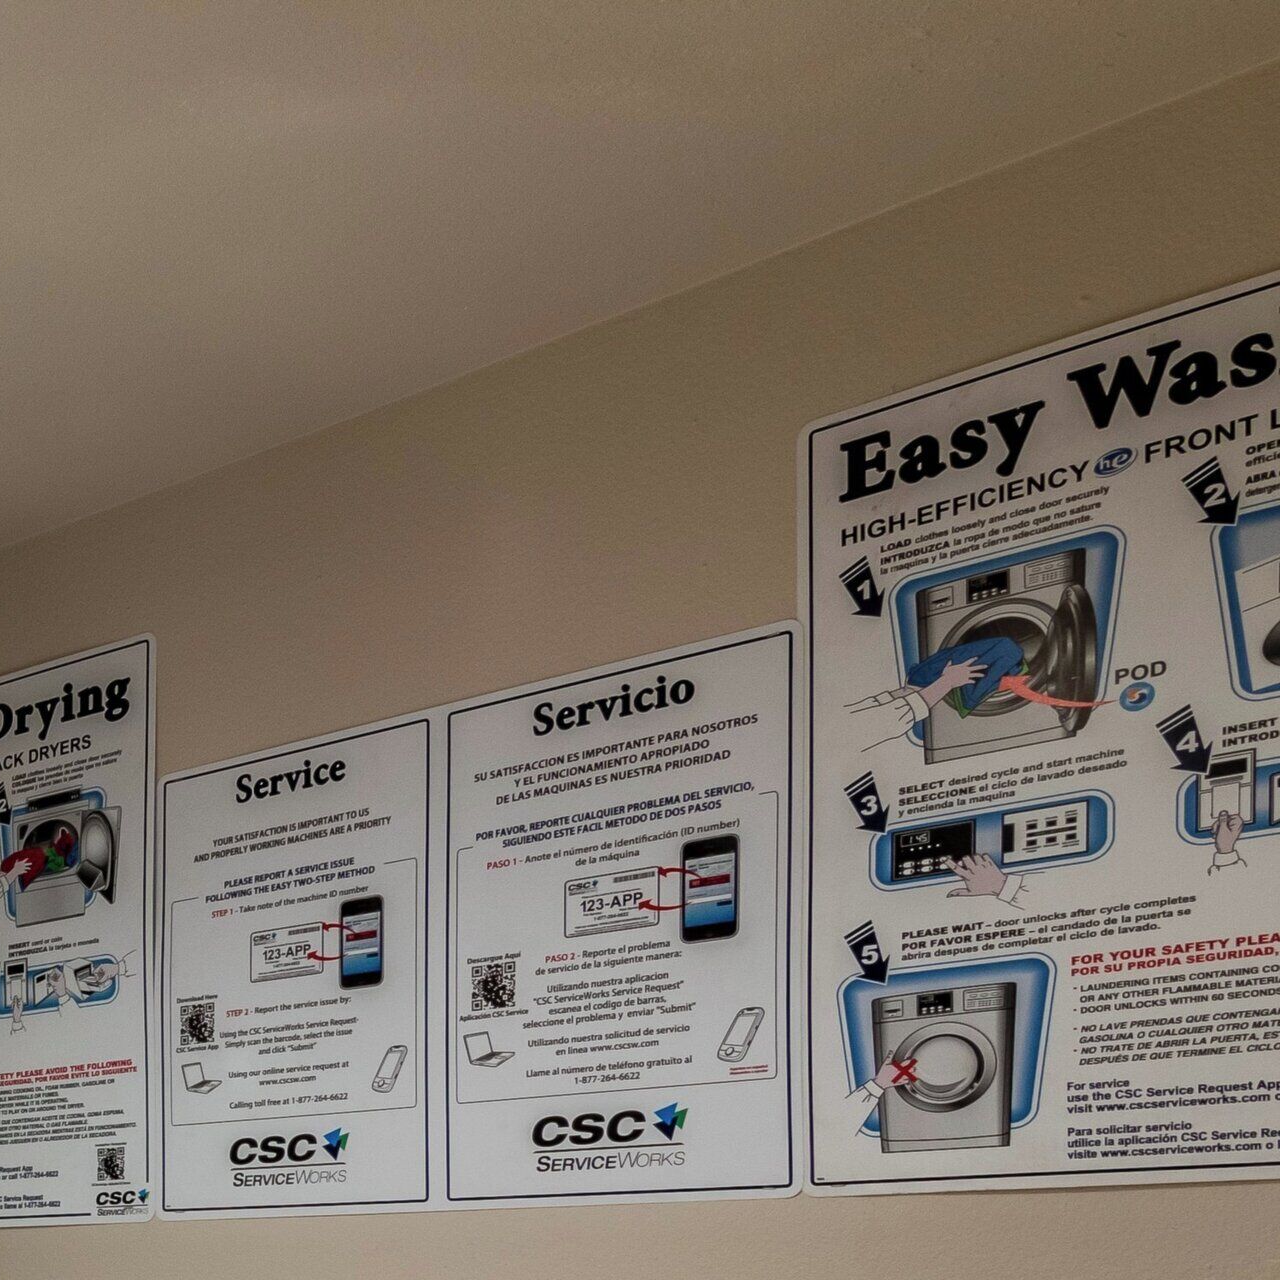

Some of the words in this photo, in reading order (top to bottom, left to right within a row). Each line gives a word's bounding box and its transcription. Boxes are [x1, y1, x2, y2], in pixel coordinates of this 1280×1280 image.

[838, 399, 1045, 503] Easy
[840, 460, 1090, 548] HIGH-EFFICIENCY
[1144, 414, 1259, 464] FRONT
[1203, 483, 1227, 508] 2
[879, 537, 912, 553] LOAD
[914, 529, 949, 544] clothes
[951, 518, 986, 534] loosely
[987, 511, 1007, 524] and
[1009, 505, 1036, 518] close
[1038, 498, 1063, 510] door
[1064, 485, 1110, 503] securely
[855, 579, 871, 597] 1
[1114, 659, 1168, 686] POD
[532, 674, 695, 736] Servicio
[1222, 717, 1279, 735] INSERT
[28, 734, 91, 764] DRYERS
[473, 771, 487, 783] SU
[489, 754, 564, 779] SATISFACCION
[566, 751, 580, 763] ES
[581, 735, 655, 760] IMPORTANTE
[657, 728, 688, 743] PARA
[691, 713, 758, 736] NOSOTROS
[1175, 730, 1199, 753] 4
[235, 759, 346, 803] Service
[898, 779, 945, 795] SELECT
[947, 771, 988, 786] desired
[990, 766, 1019, 779] cycle
[1022, 761, 1043, 773] and
[1046, 756, 1072, 769] start
[1074, 748, 1124, 767] machine
[861, 795, 878, 816] 3
[193, 852, 210, 863] AND
[210, 844, 248, 860] PROPERLY
[248, 837, 286, 852] WORKING
[286, 828, 328, 844] MACHINES
[329, 824, 345, 836] ARE
[345, 823, 352, 833] A
[353, 815, 391, 831] PRIORITY
[212, 835, 233, 847] YOUR
[234, 824, 288, 843] SATISFACTION
[288, 822, 296, 831] IS
[297, 812, 344, 830] IMPORTANT
[345, 809, 357, 820] TO
[358, 807, 369, 817] US
[580, 891, 643, 913] 123-APP
[262, 943, 312, 962] 123-APP
[861, 945, 879, 965] 5
[1070, 952, 1104, 965] FOR
[1108, 946, 1156, 961] YOUR
[1161, 937, 1229, 955] SAFETY
[225, 1008, 243, 1018] STEP
[243, 1008, 249, 1016] 2
[253, 1004, 278, 1014] Report
[279, 1002, 292, 1011] the
[292, 1000, 318, 1009] service
[319, 997, 338, 1006] issue
[15, 1068, 43, 1078] PLEASE
[45, 1066, 68, 1074] AVOID
[86, 1058, 132, 1070] FOLLOWING
[574, 1071, 640, 1084] 1-877-264-6622
[1066, 1081, 1086, 1091] For
[1088, 1078, 1130, 1090] service
[228, 1100, 253, 1109] Calling
[253, 1098, 266, 1107] toll
[266, 1098, 281, 1106] free
[281, 1097, 289, 1105] at
[291, 1092, 348, 1104] 1-877-264-6622
[1066, 1103, 1092, 1114] visit
[1095, 1093, 1270, 1112] www.cscserviceworks.com
[531, 1109, 646, 1147] CSC
[229, 1133, 317, 1165] CSC
[95, 1189, 137, 1205] CSC
